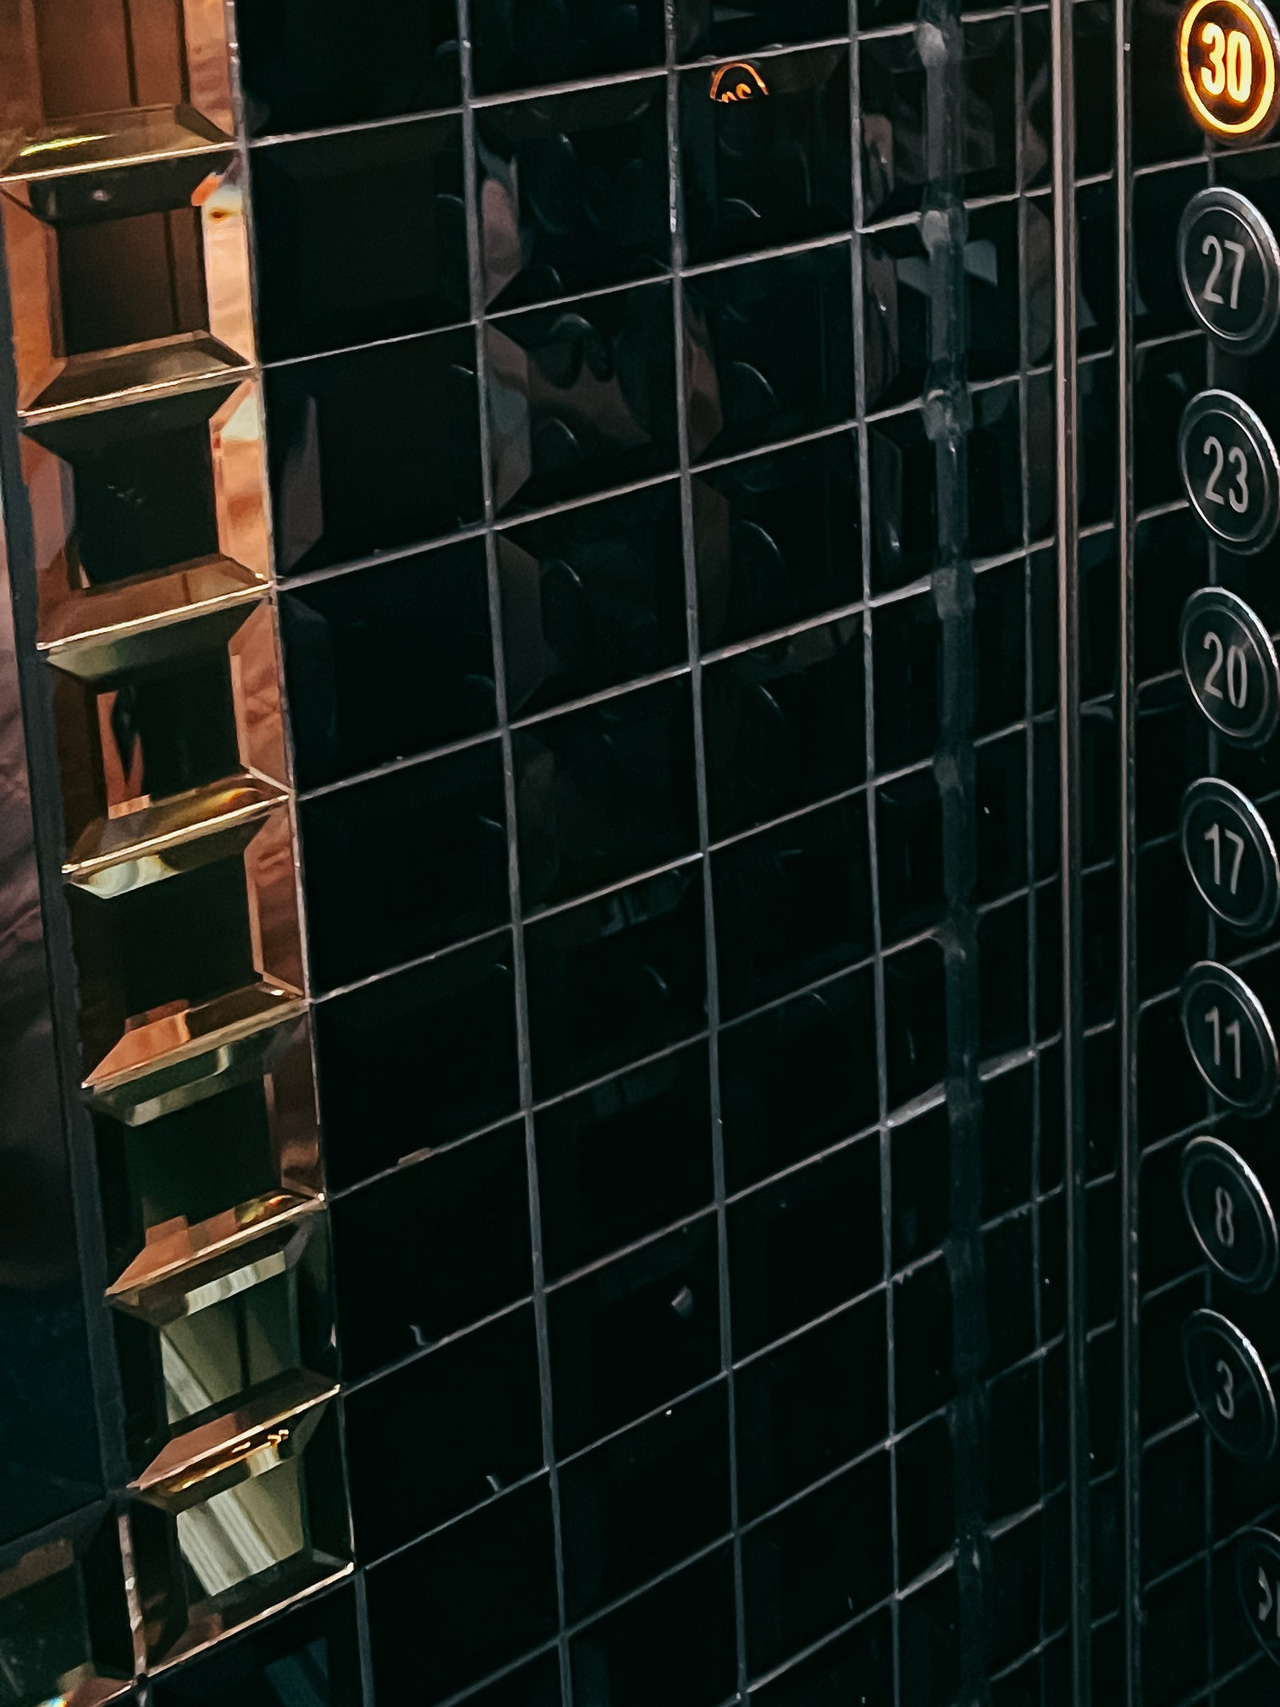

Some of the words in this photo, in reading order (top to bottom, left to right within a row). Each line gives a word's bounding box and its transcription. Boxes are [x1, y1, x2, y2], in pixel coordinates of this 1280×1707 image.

[1201, 21, 1252, 103] 30
[1203, 235, 1245, 308] 27
[1203, 436, 1249, 513] 23
[1203, 632, 1246, 708] 20
[1204, 823, 1243, 894] 17
[1205, 1005, 1241, 1080] 11
[1214, 1185, 1235, 1247] 8
[1215, 1359, 1235, 1419] 3
